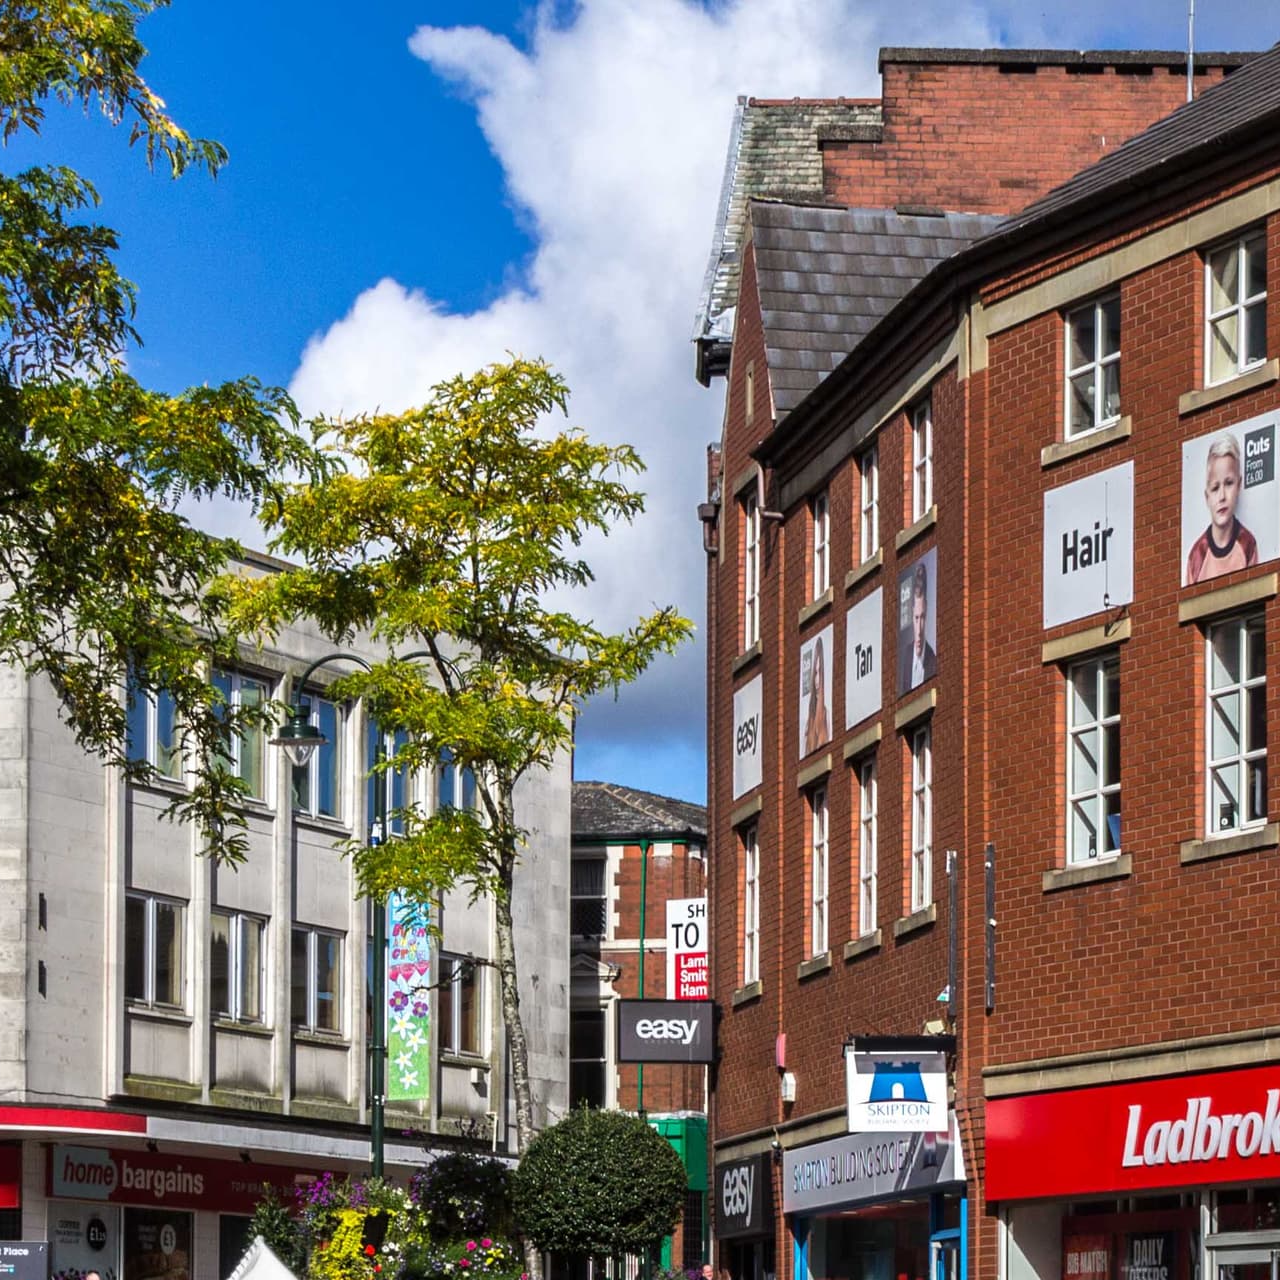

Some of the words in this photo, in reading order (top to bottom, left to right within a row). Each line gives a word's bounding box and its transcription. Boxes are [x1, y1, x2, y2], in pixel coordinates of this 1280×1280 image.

[1247, 436, 1270, 458] Cuts
[1246, 459, 1263, 472] From
[1062, 521, 1113, 574] Hair
[855, 643, 872, 680] Tan
[736, 713, 759, 756] easy
[671, 922, 700, 949] TO
[636, 1018, 699, 1044] easy
[867, 1104, 930, 1116] SKIPTON
[63, 1155, 115, 1186] home
[122, 1160, 204, 1197] bargains
[793, 1158, 830, 1193] SKIPTON
[830, 1147, 873, 1185] BUILDING
[722, 1165, 755, 1227] easy
[3, 1247, 29, 1256] Place
[1133, 1238, 1164, 1267] DAILY
